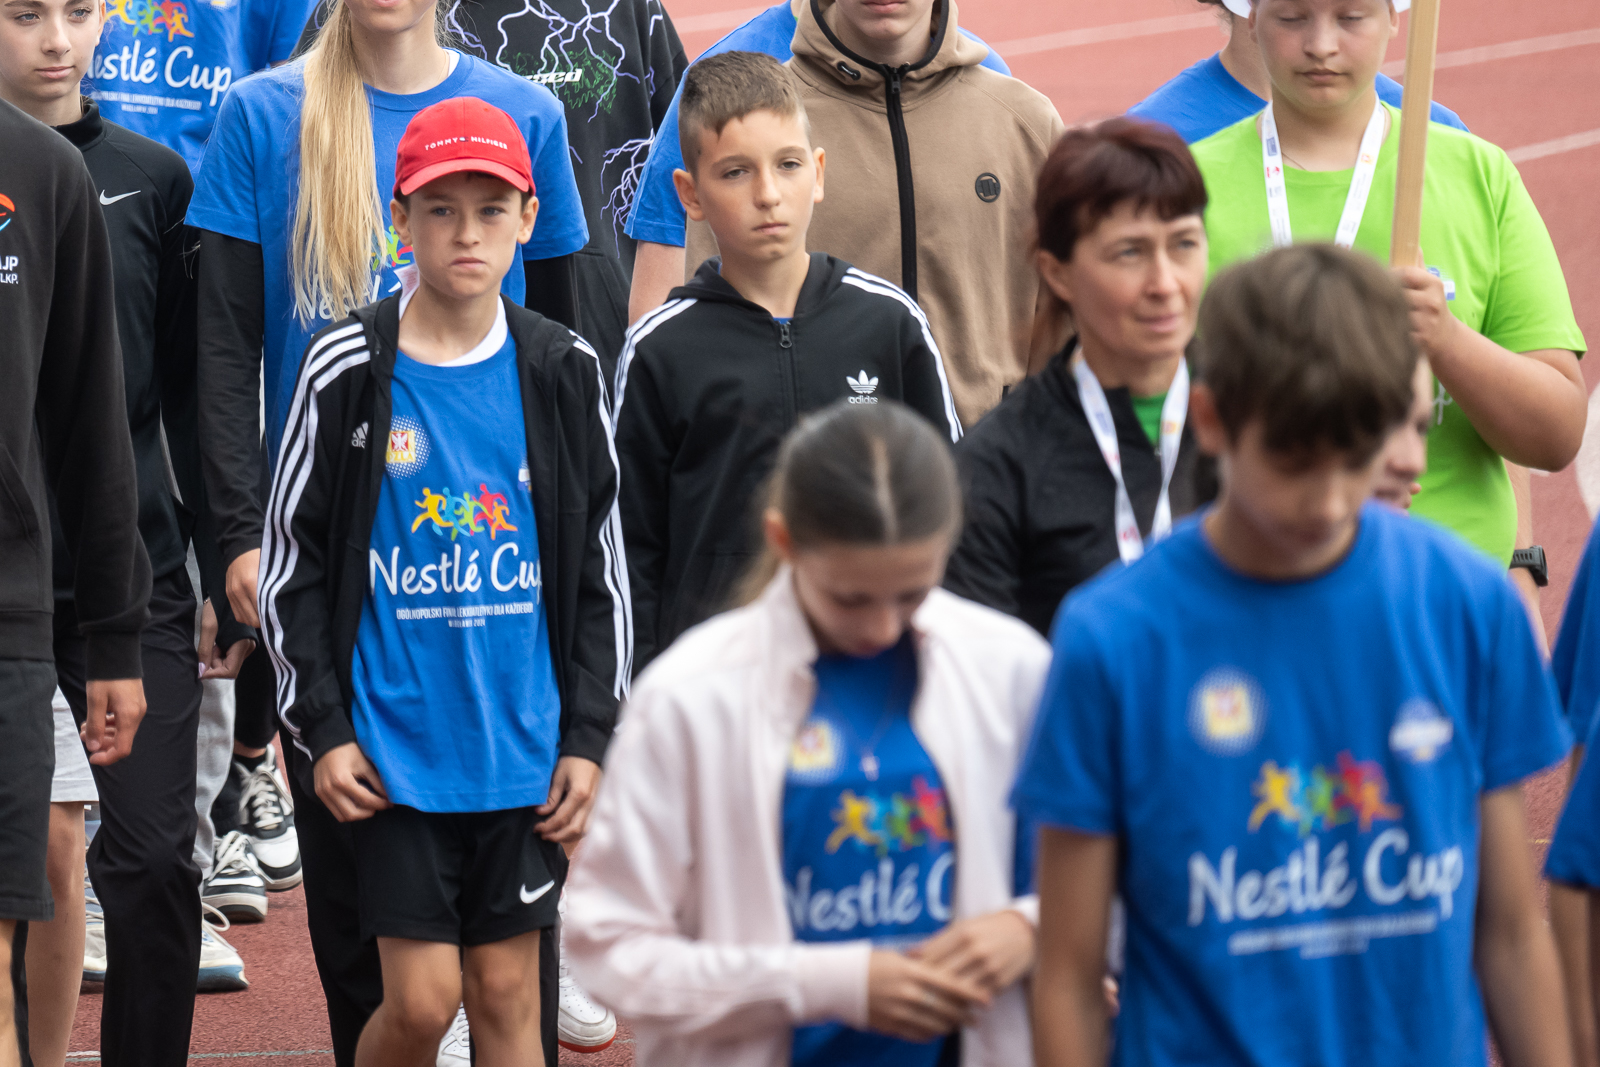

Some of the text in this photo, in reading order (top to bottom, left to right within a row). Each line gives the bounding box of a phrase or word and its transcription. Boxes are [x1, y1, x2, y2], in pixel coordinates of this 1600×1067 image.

[164, 45, 232, 107] Cup
[424, 136, 508, 151] TOMMY HILFIGER
[848, 395, 878, 404] adidas
[369, 543, 482, 596] Nestlé
[1187, 828, 1464, 927] Nestlé Cup
